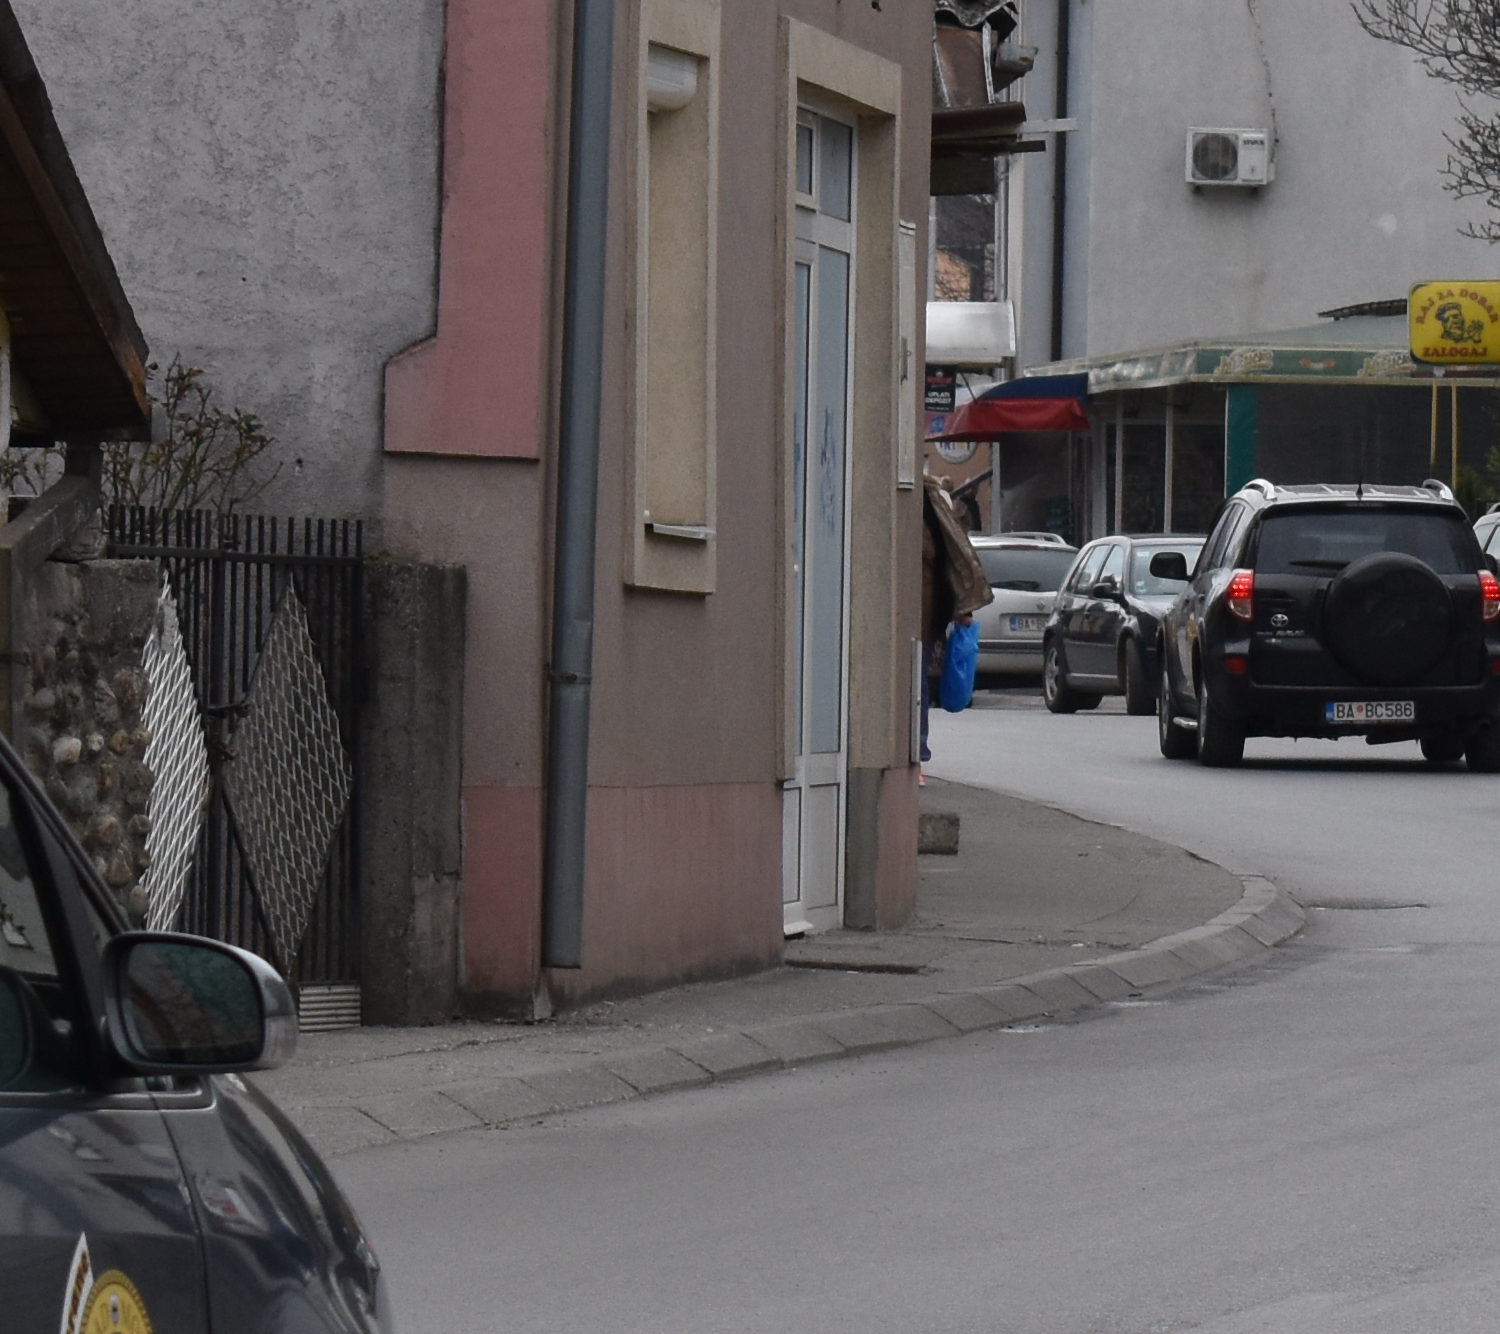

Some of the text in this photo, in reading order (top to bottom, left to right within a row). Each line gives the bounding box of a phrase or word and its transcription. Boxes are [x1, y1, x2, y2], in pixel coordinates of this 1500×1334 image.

[1423, 347, 1488, 357] ZALOGAJ
[1336, 702, 1413, 719] BA BC586
